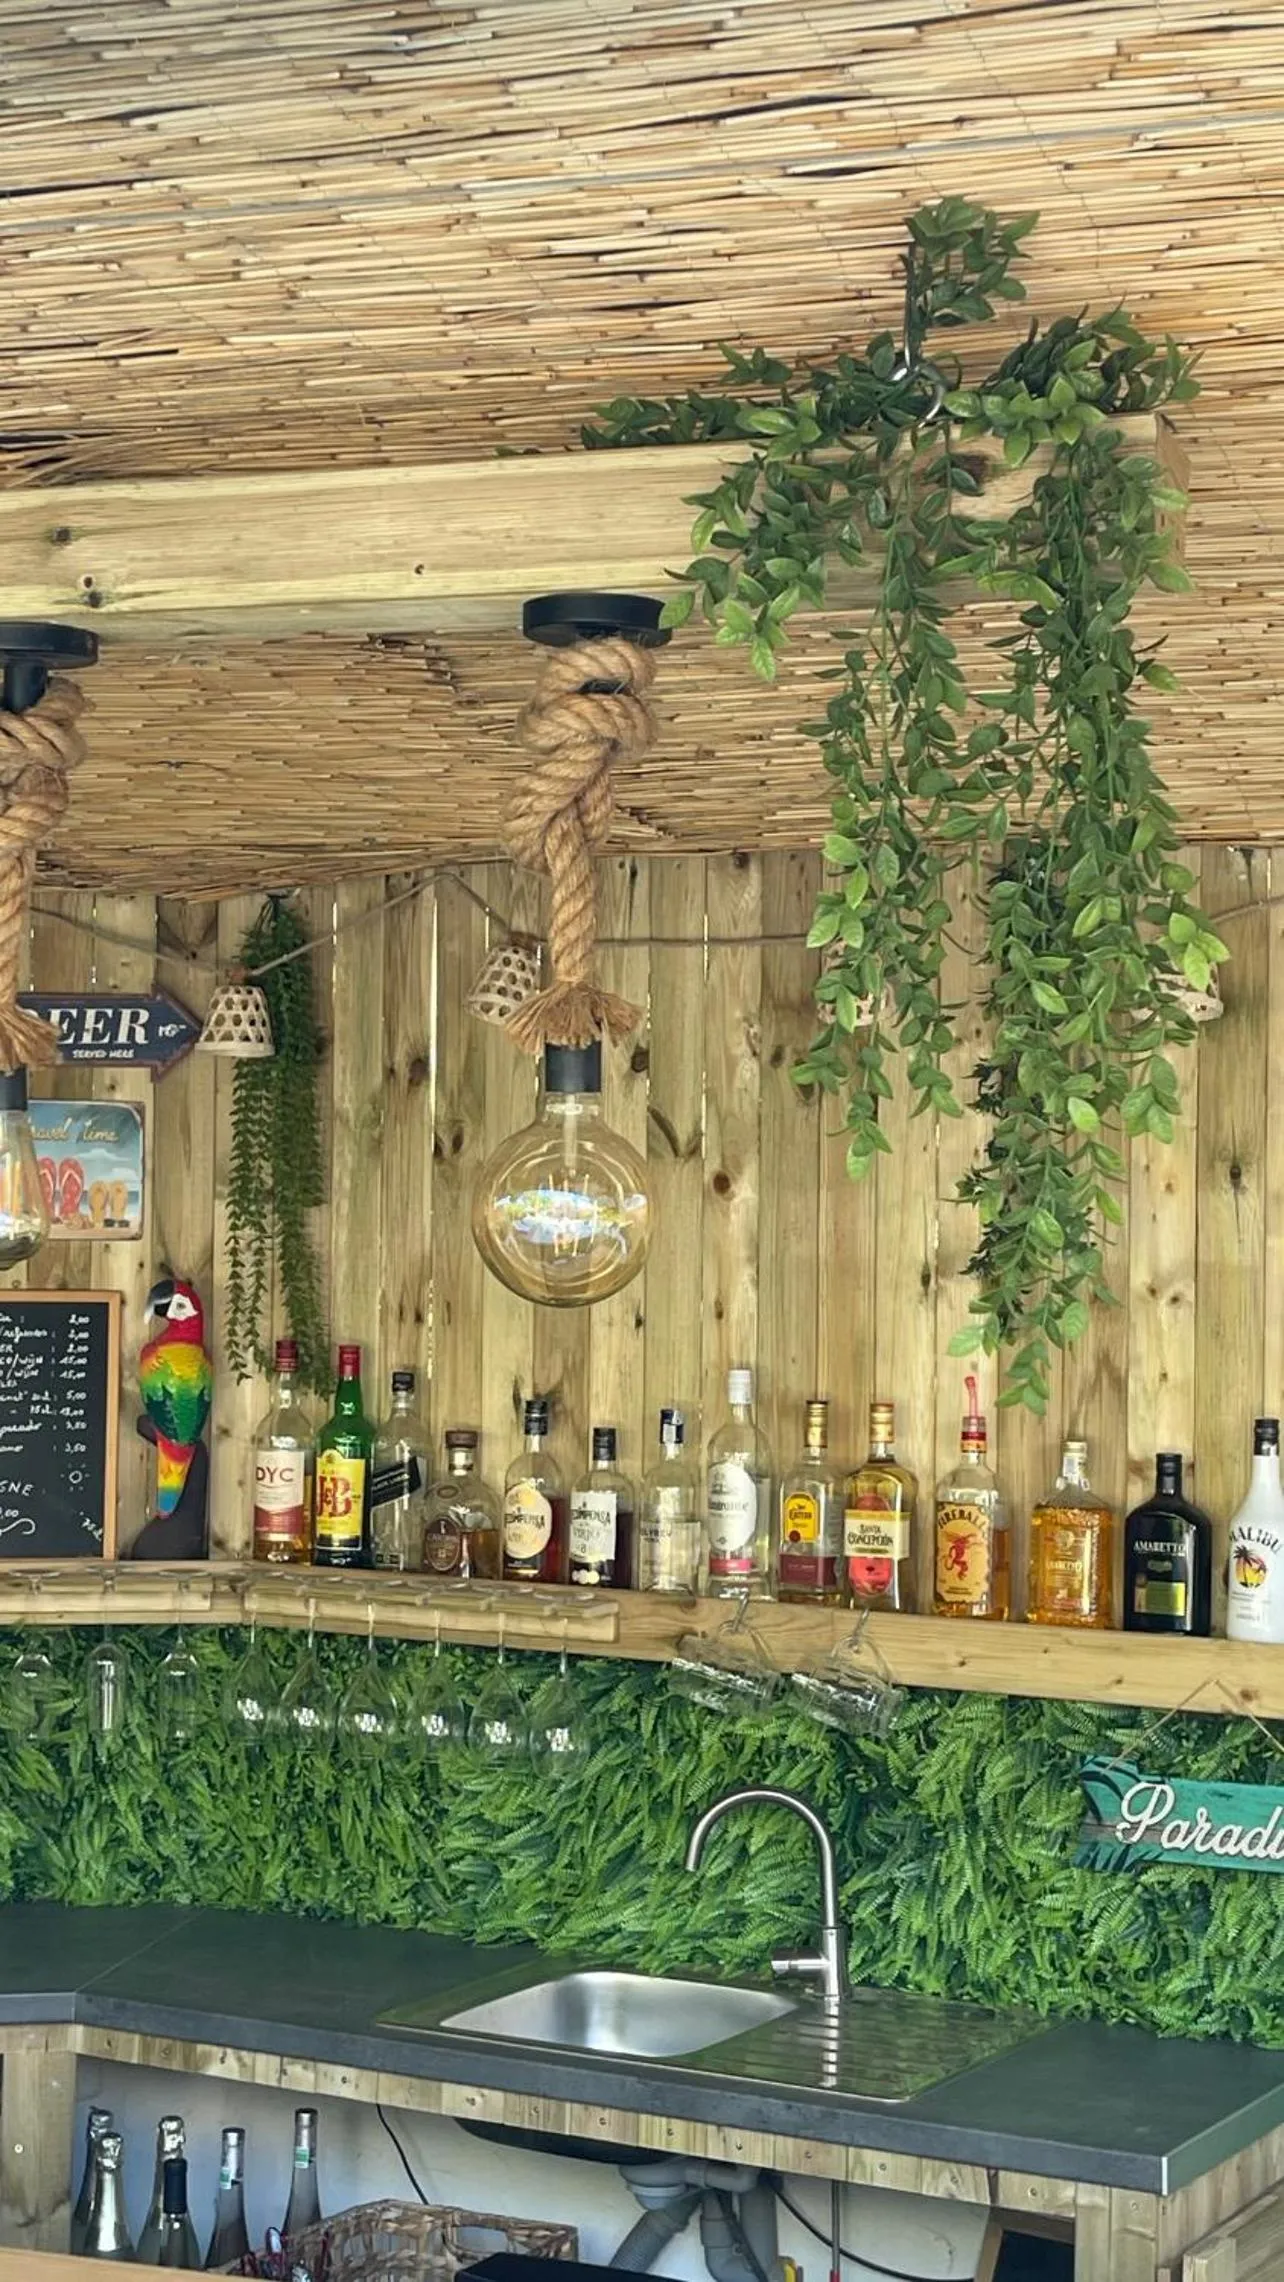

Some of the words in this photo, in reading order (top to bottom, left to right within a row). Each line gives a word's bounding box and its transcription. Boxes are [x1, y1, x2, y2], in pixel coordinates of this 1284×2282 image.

[108, 1049, 135, 1059] HERE
[256, 1466, 294, 1483] DYC
[1133, 1539, 1187, 1553] AMARETTO
